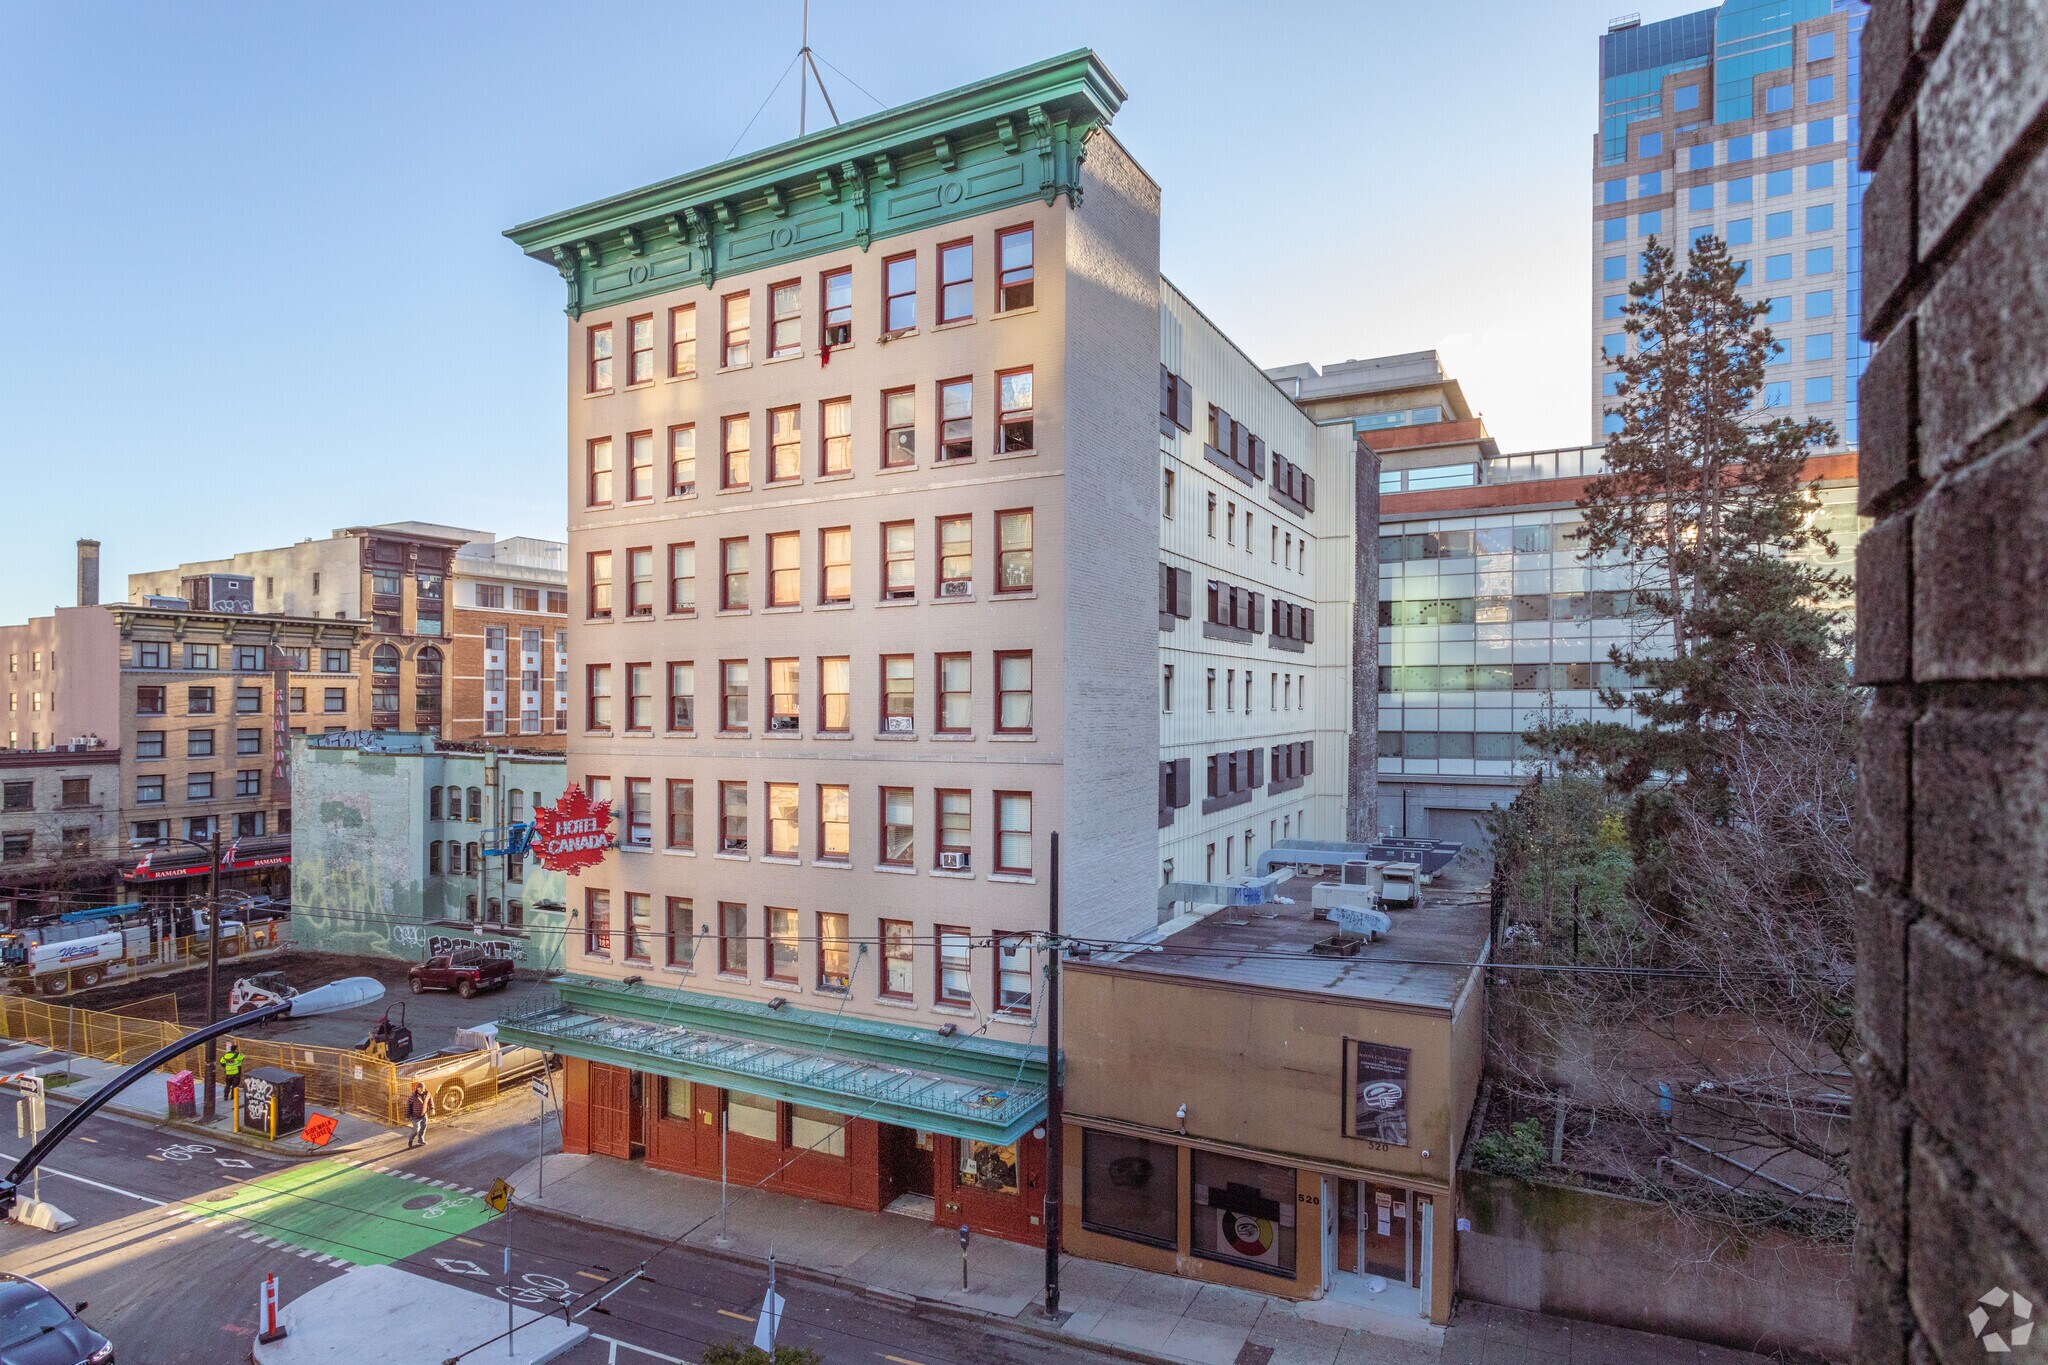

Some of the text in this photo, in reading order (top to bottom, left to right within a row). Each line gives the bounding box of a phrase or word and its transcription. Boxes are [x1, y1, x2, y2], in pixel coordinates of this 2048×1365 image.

[275, 688, 285, 778] RAMADA
[556, 818, 601, 836] HOTEL
[548, 833, 609, 855] CANADA
[254, 857, 283, 866] RAMADA
[155, 868, 187, 878] RAMADA
[305, 1120, 332, 1136] SIDEWALK
[310, 1127, 332, 1141] CLOSED
[1368, 1141, 1389, 1152] 520
[1298, 1193, 1320, 1206] 520
